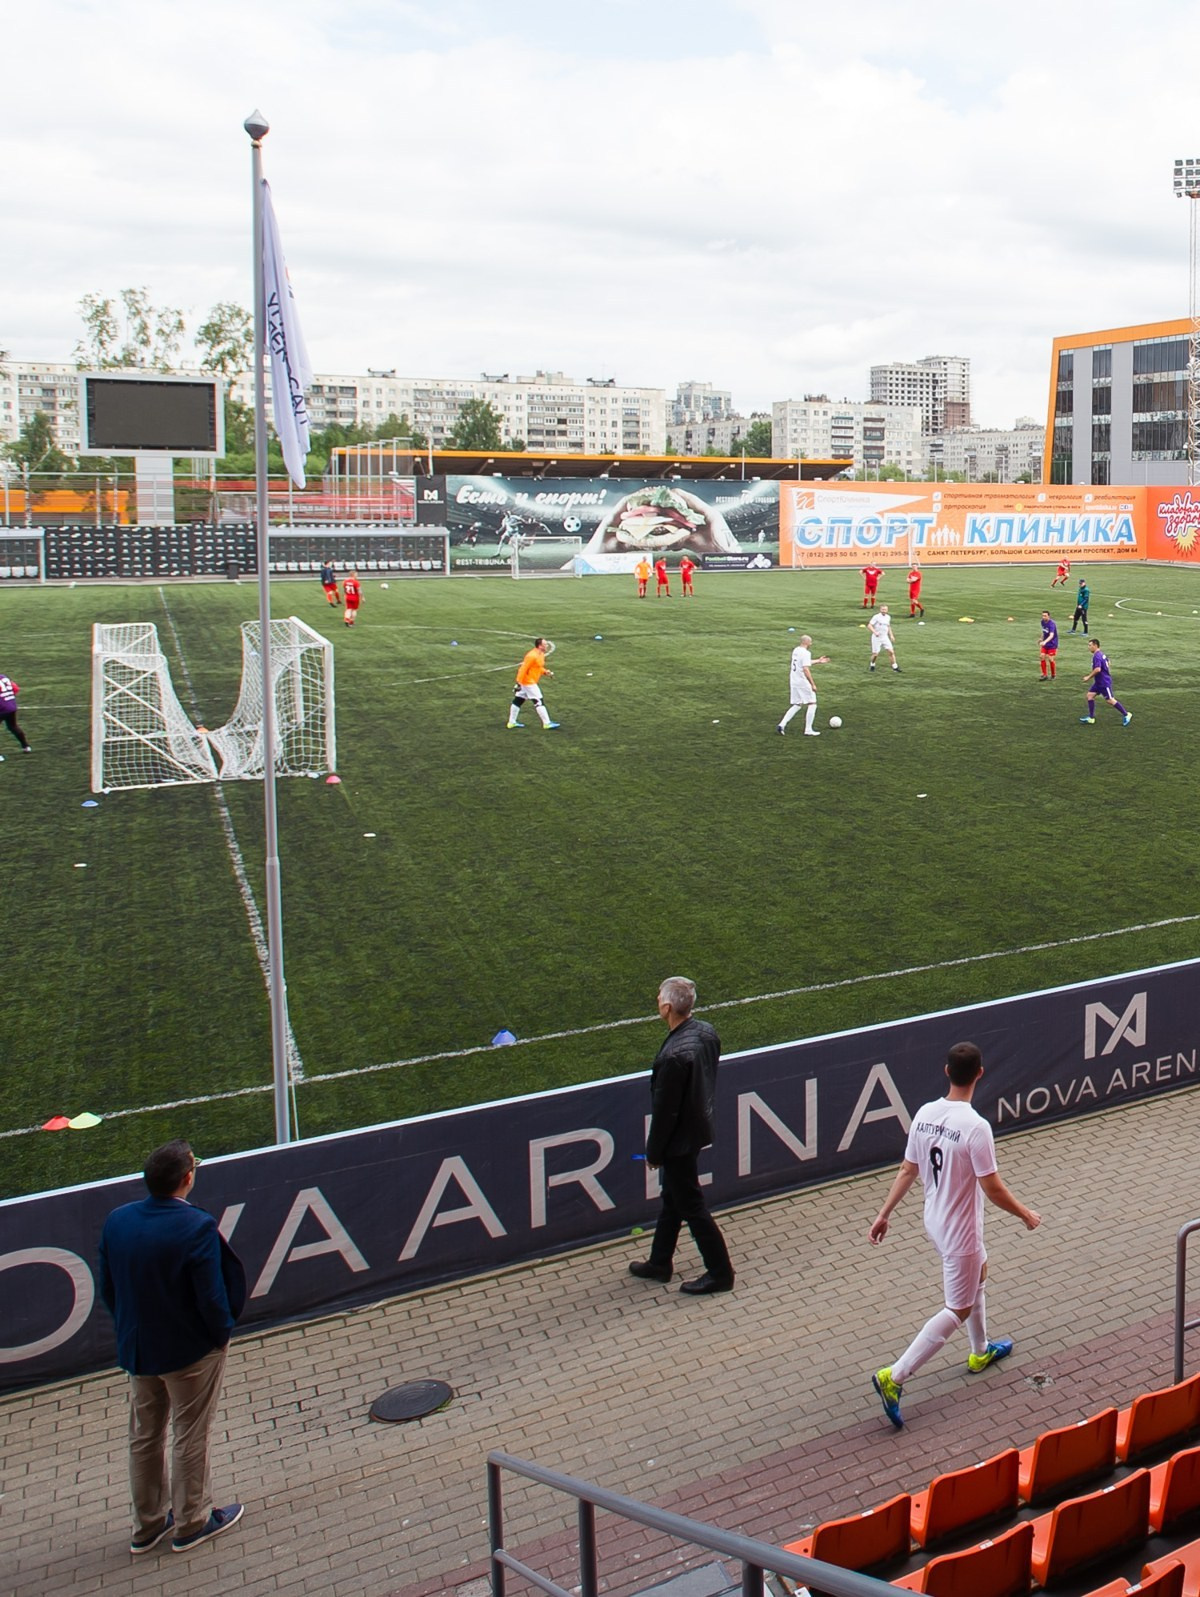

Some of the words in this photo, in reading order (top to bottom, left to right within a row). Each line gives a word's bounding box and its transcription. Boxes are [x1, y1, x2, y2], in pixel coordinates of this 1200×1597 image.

[535, 488, 607, 513] спорт!
[795, 515, 936, 547] СПОРТ
[965, 514, 1136, 546] КЛИНИКА
[456, 558, 515, 566] REST-TRIBUNA.R
[997, 1075, 1098, 1123] NOVA
